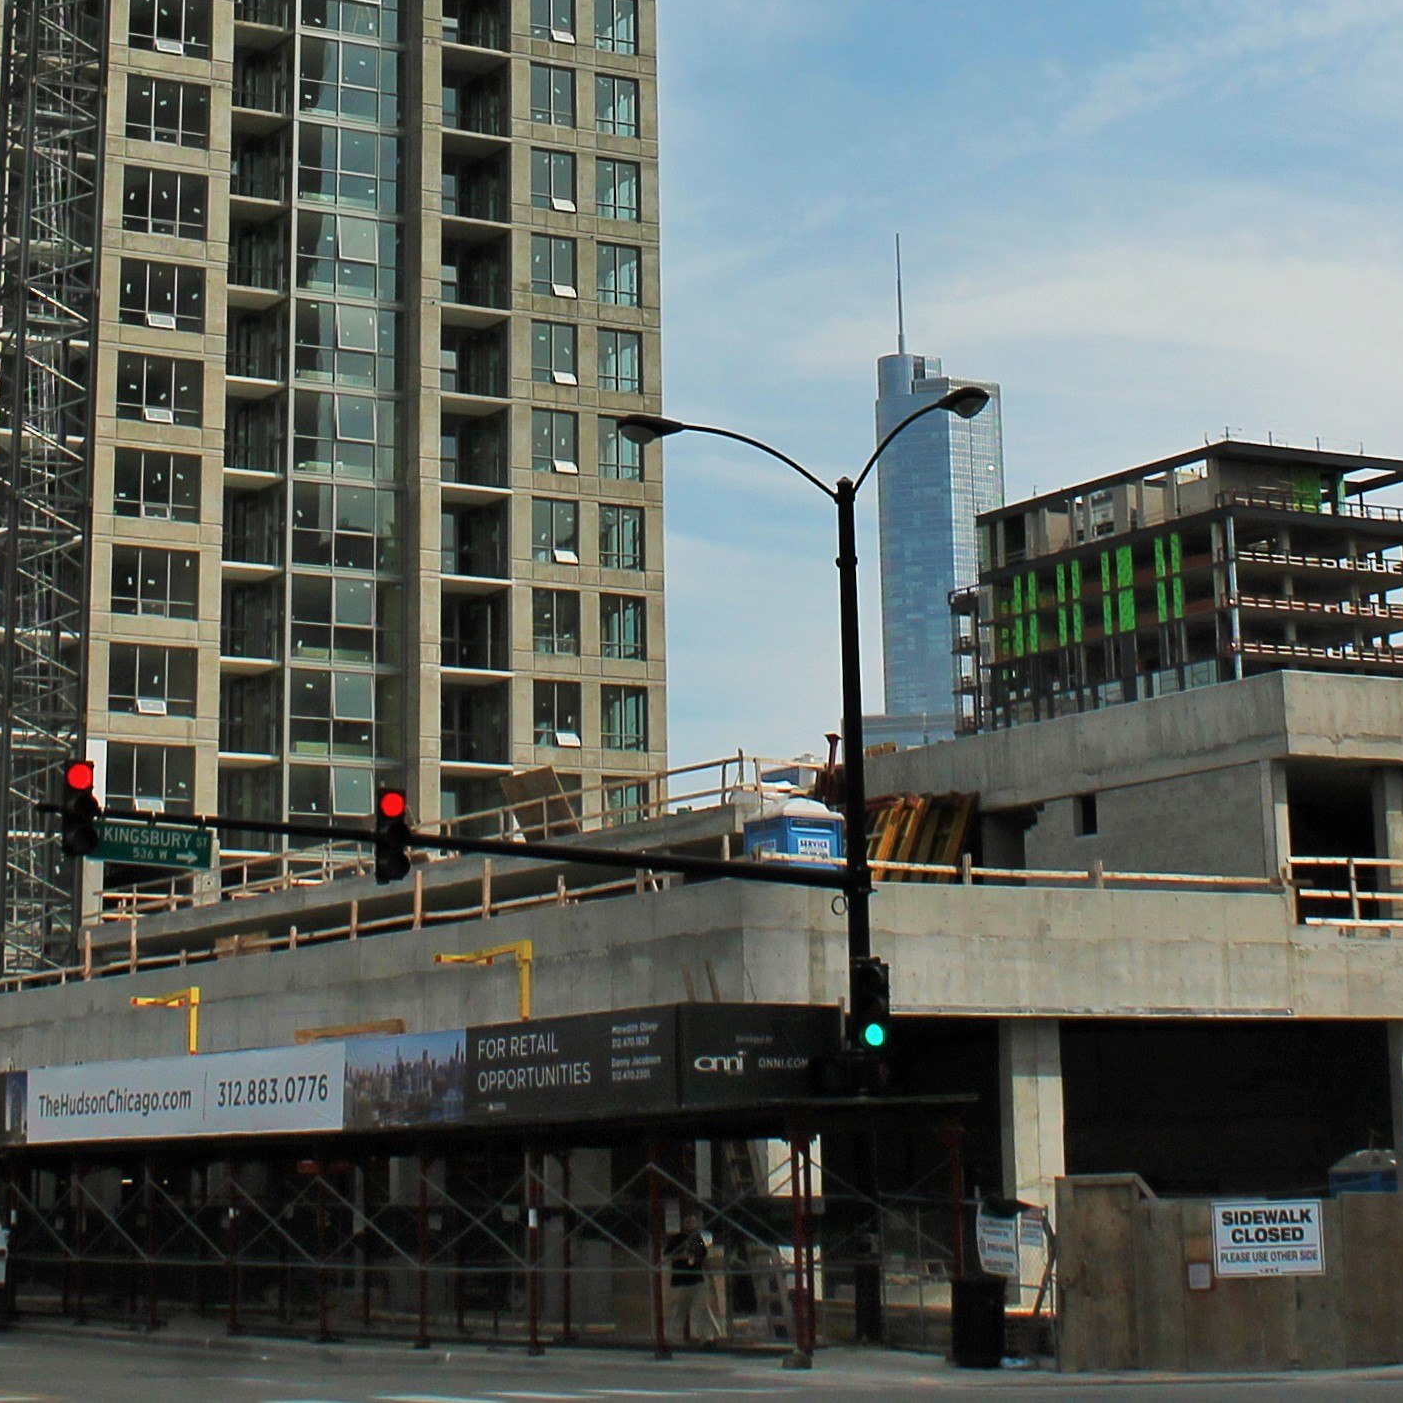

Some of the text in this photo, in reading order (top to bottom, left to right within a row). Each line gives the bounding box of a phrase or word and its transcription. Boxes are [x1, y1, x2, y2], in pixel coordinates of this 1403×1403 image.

[103, 826, 192, 848] KINGSBURY
[196, 836, 207, 847] ST
[800, 839, 828, 848] SERVICE
[133, 847, 167, 860] 536 W
[478, 1032, 559, 1061] FOR RETAIL
[694, 1051, 808, 1073] onni ONNI.COM
[477, 1061, 591, 1093] OPPORTUNITIES
[217, 1074, 329, 1108] 312.883.0776
[38, 1088, 192, 1117] TheHudsonChicago.com
[1221, 1208, 1313, 1227] SIDEWALK
[1231, 1226, 1305, 1244] CLOSED
[1220, 1249, 1318, 1264] PLEASE USE OTHER SIDE
